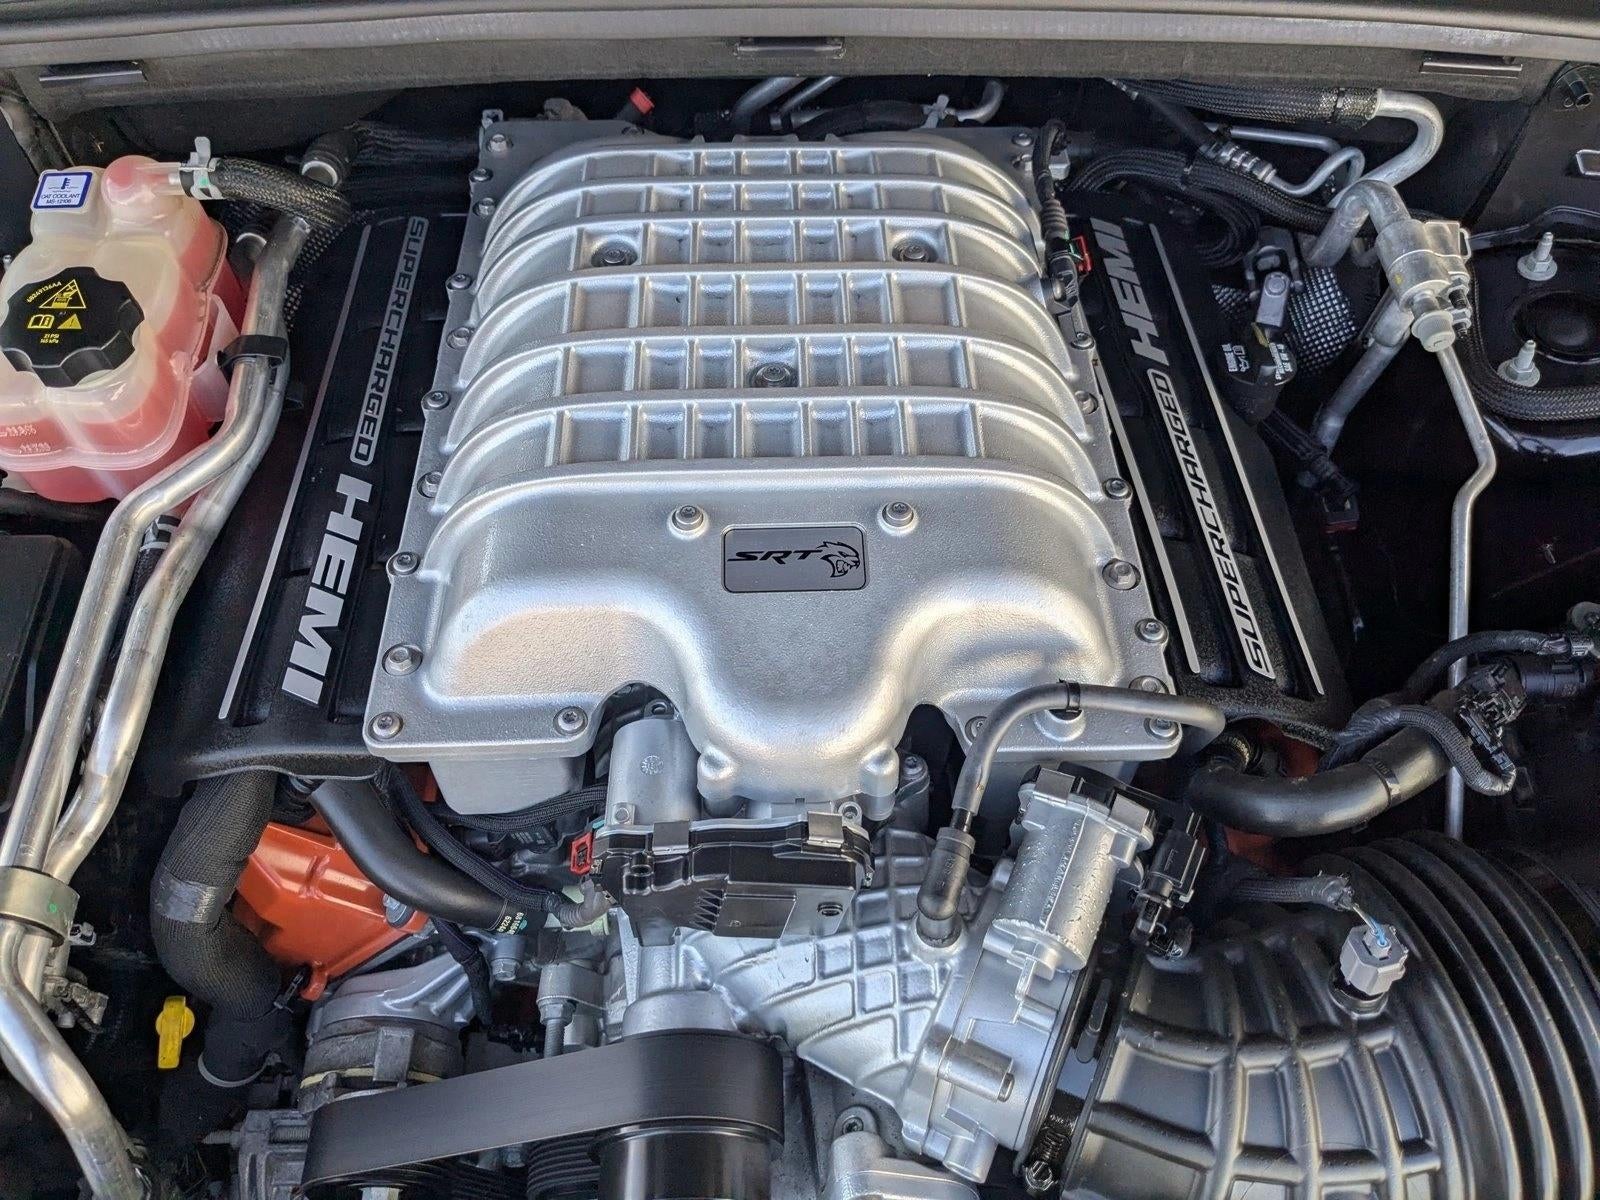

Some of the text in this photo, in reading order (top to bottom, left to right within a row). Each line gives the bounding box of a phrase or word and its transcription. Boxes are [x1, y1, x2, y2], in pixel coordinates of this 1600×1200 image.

[281, 217, 429, 705] SUPERCHARGED HEMI
[727, 550, 823, 565] SRT
[1091, 217, 1275, 680] HEMI SUPERCHARGED
